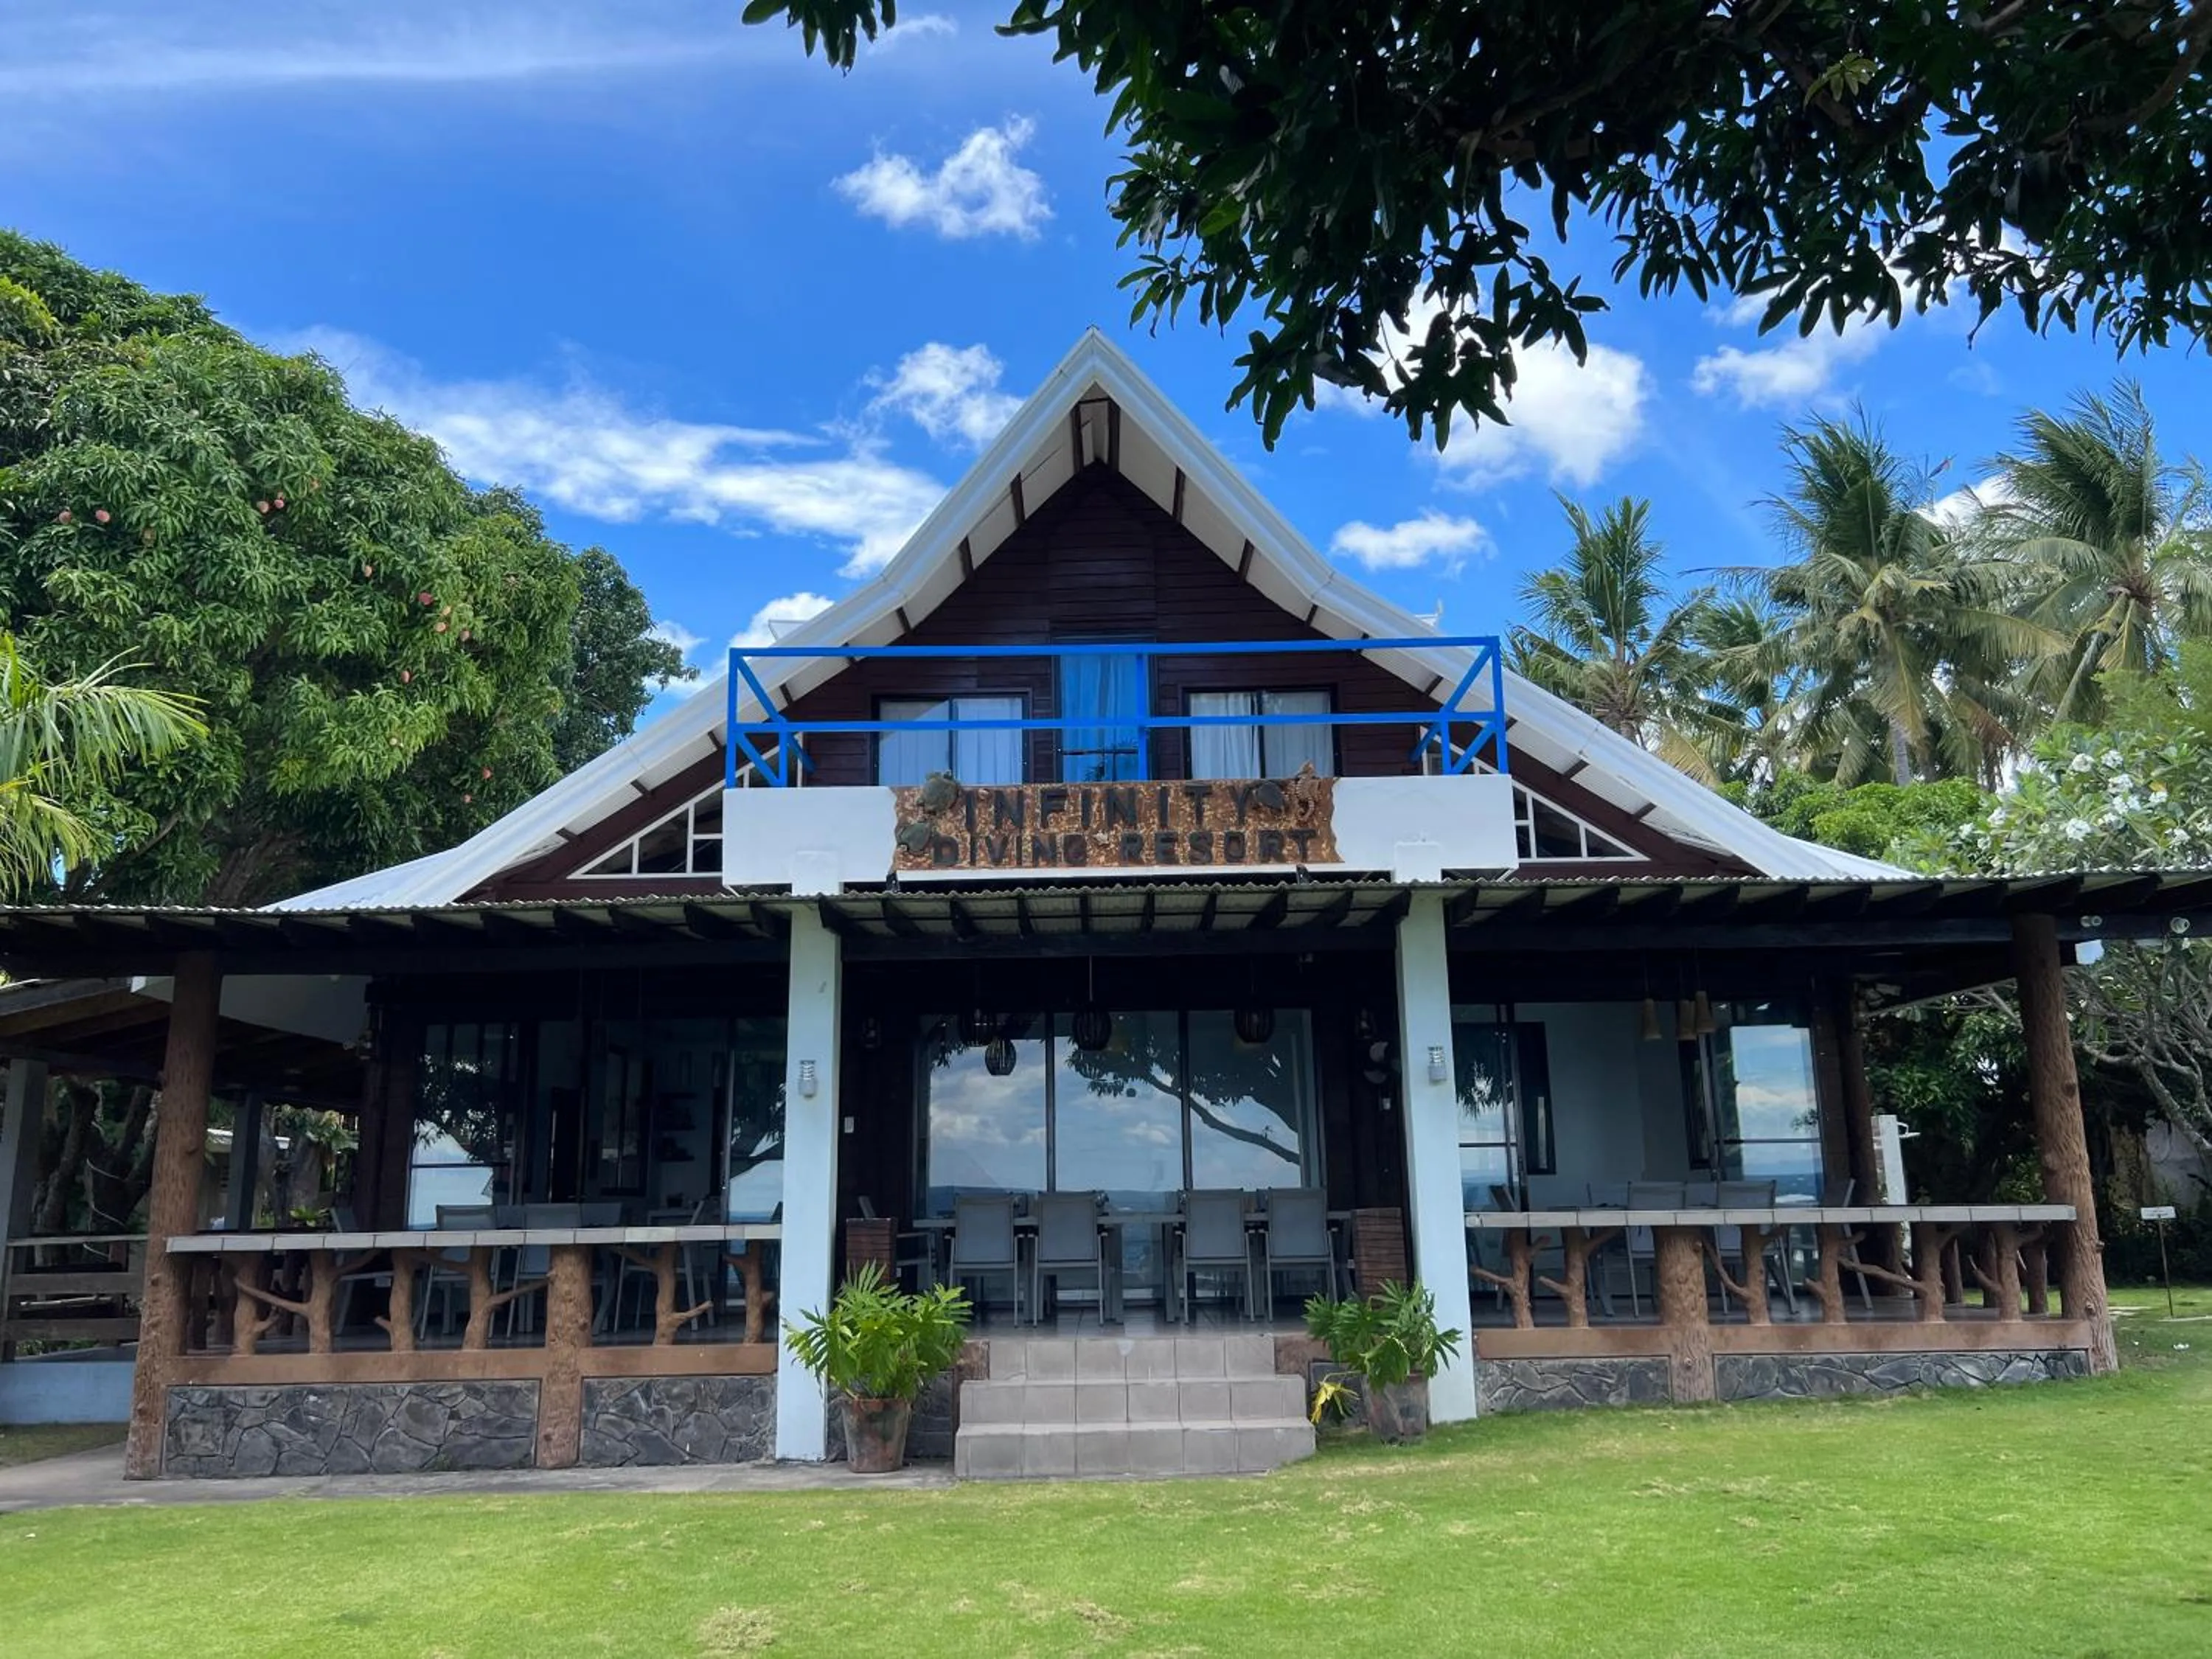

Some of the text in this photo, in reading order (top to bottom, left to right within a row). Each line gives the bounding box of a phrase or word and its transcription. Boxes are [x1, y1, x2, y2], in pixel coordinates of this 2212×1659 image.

[965, 785, 1255, 830] INFINITY
[932, 830, 1316, 866] DIVING RESORT
